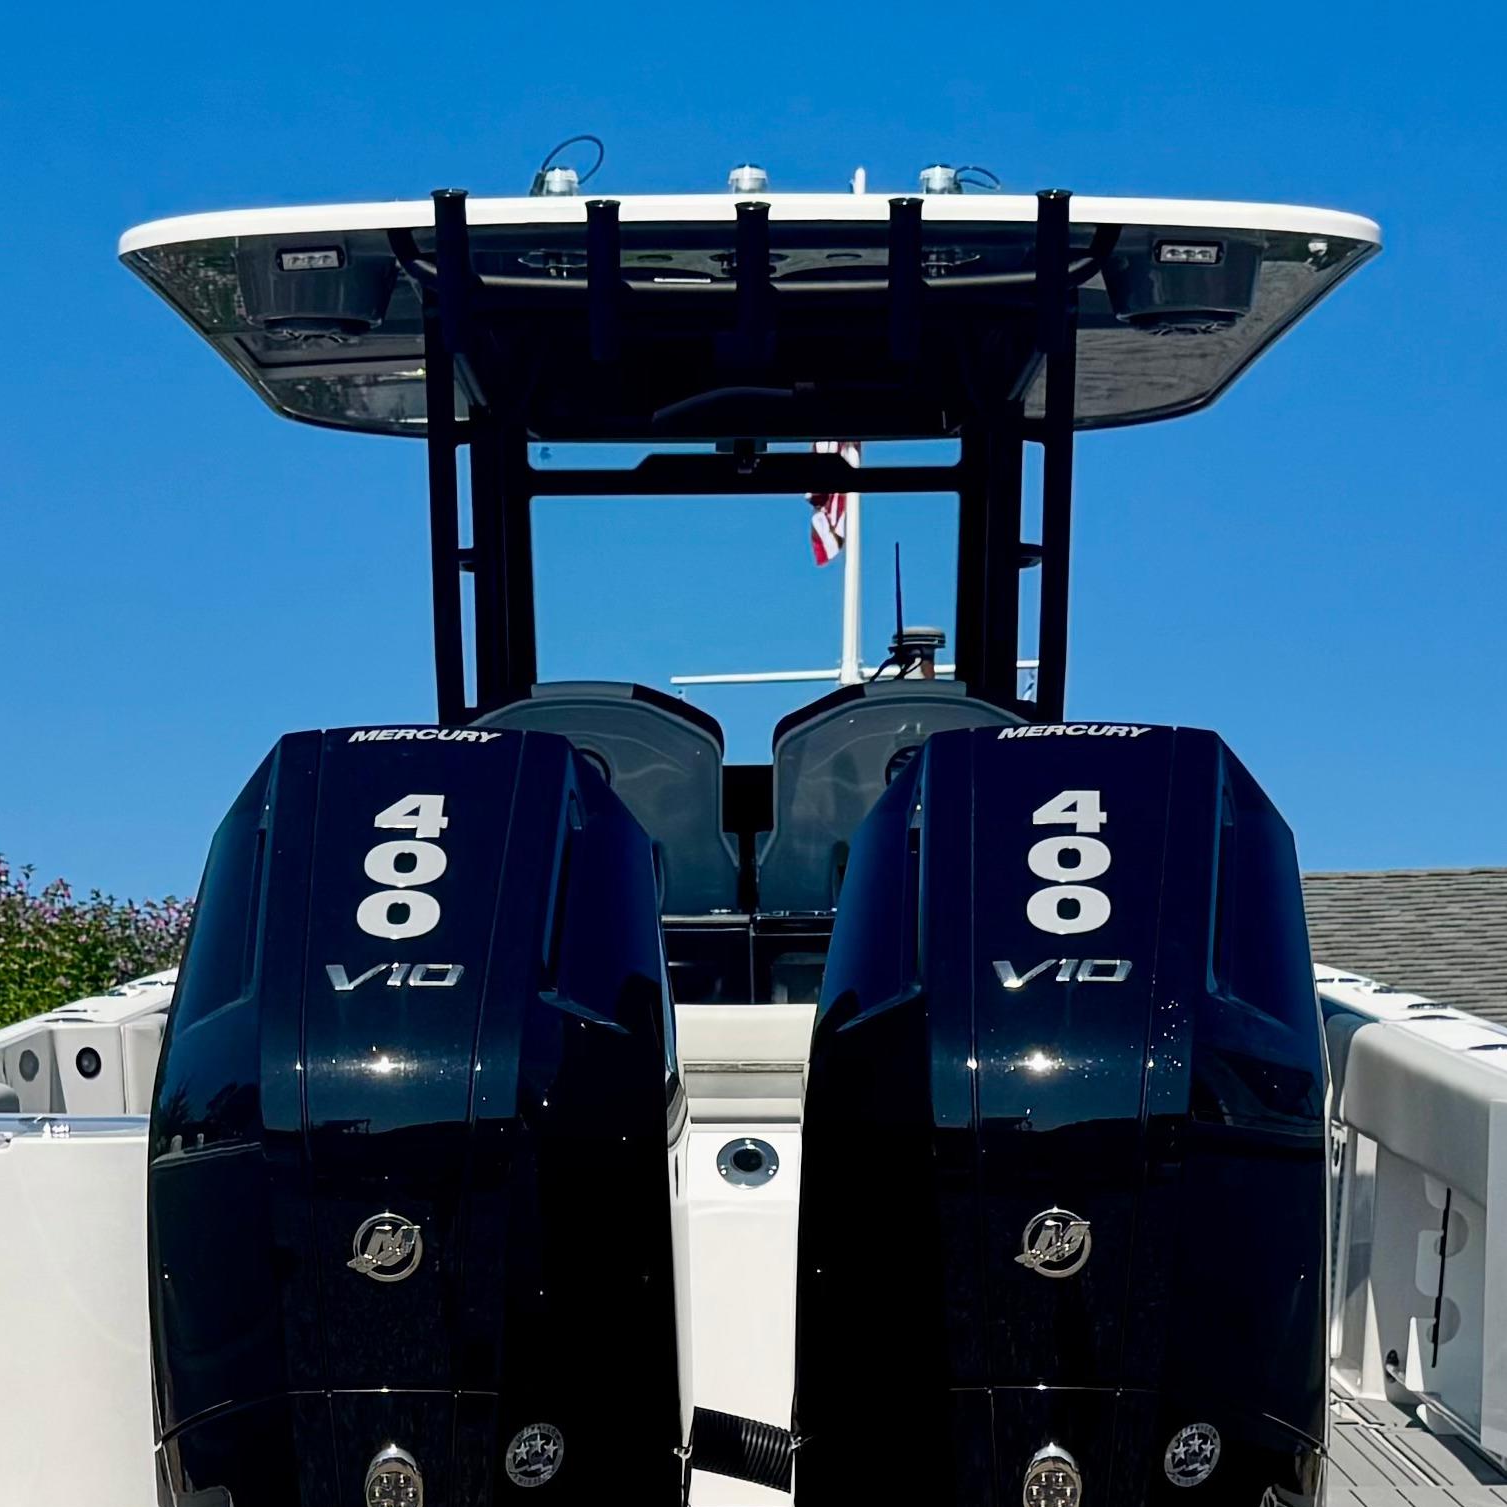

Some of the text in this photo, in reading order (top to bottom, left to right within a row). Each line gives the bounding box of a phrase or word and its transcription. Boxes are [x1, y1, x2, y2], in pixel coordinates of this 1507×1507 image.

[348, 728, 501, 743] MERCURY
[997, 724, 1151, 739] MERCURY
[325, 962, 465, 991] V10
[993, 958, 1133, 988] V10
